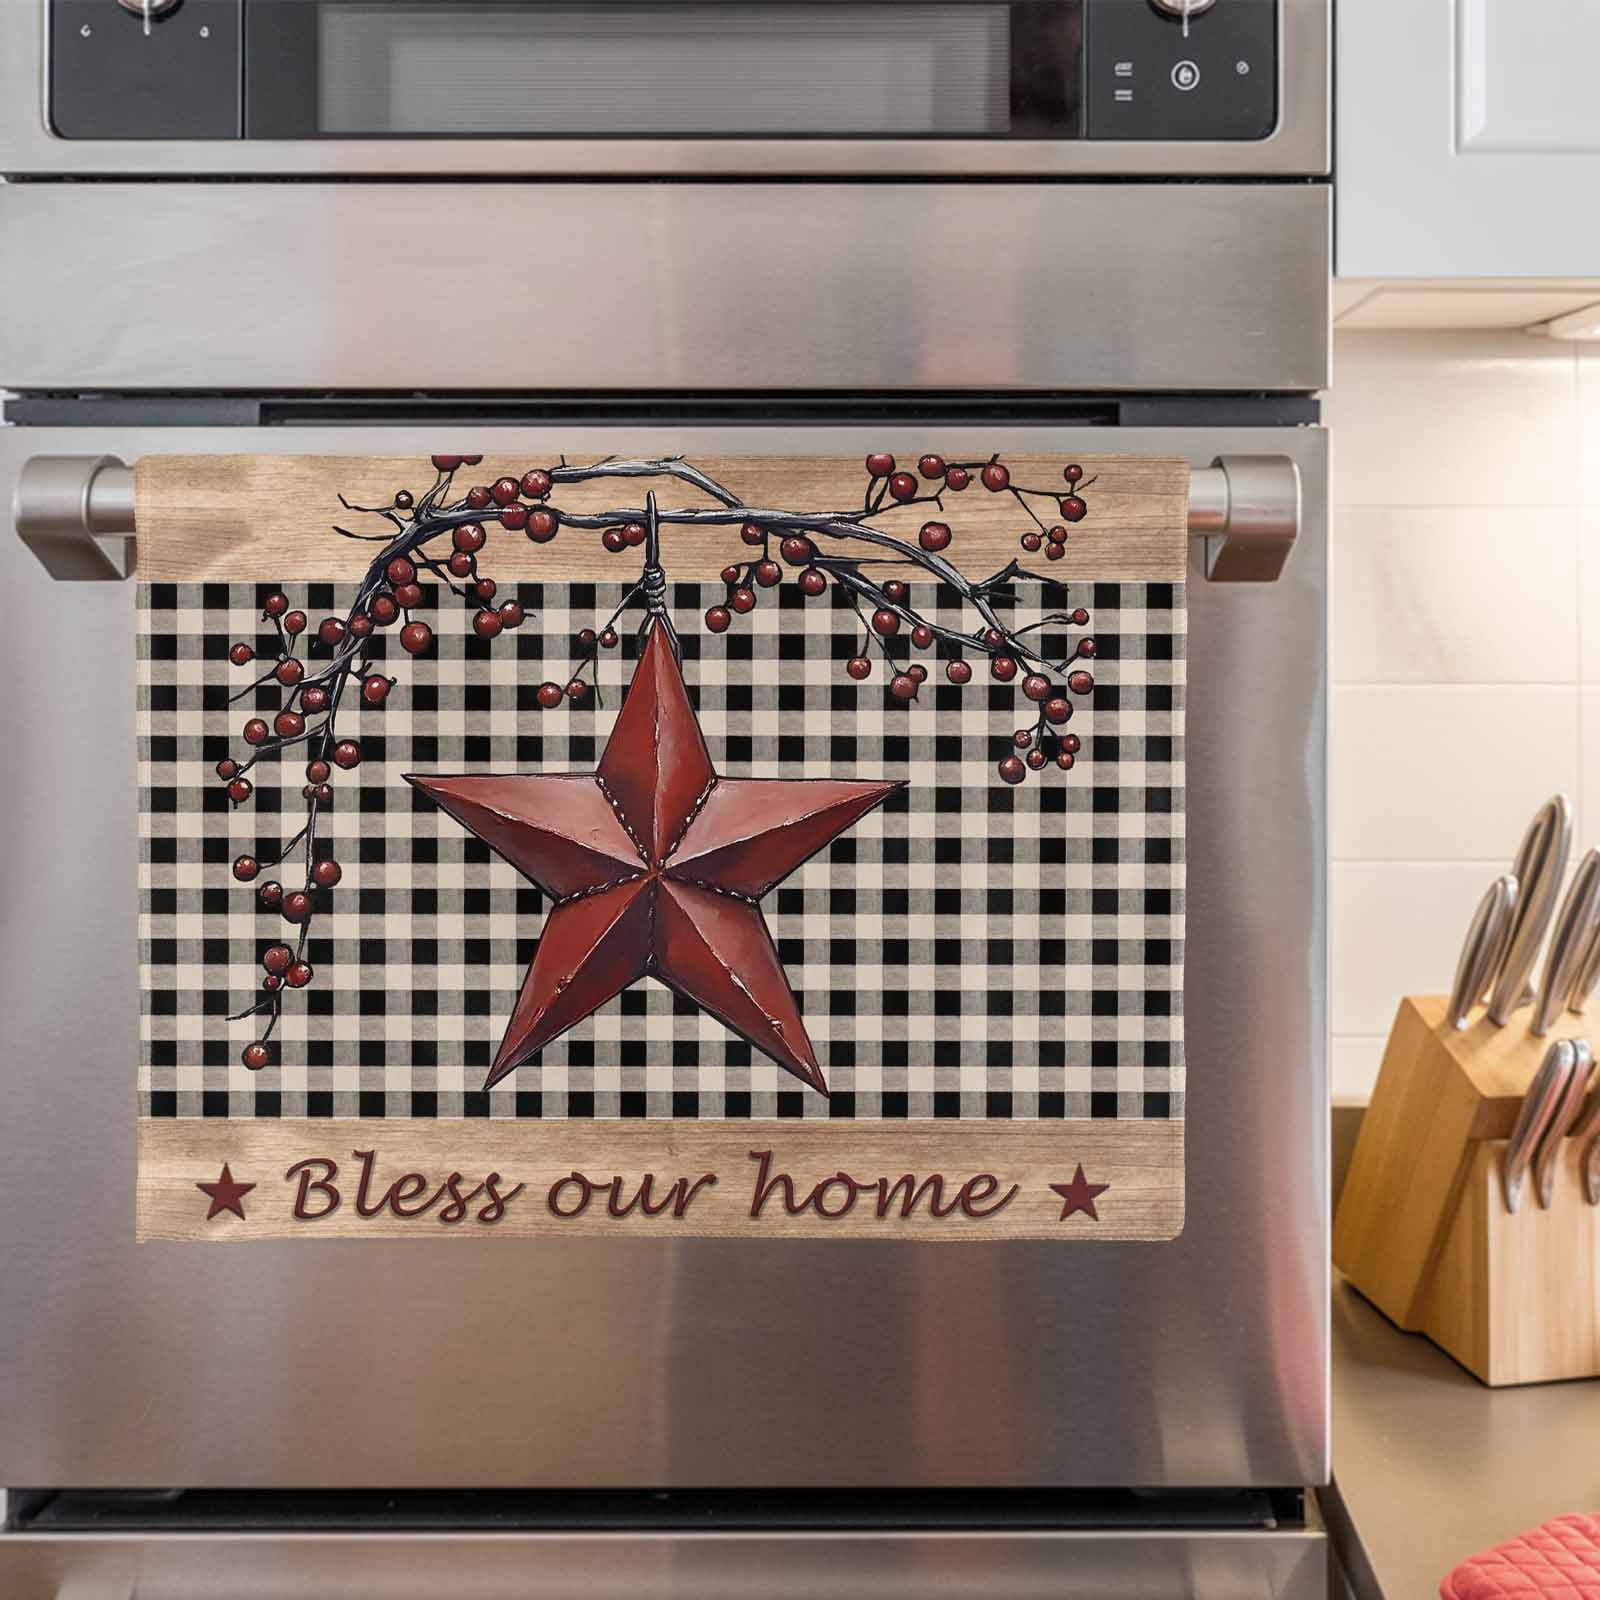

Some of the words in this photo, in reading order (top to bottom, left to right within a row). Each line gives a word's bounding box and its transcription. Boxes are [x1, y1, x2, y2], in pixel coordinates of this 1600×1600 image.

[286, 1150, 524, 1224] Bless
[548, 1169, 717, 1220] our
[750, 1150, 1019, 1221] home
